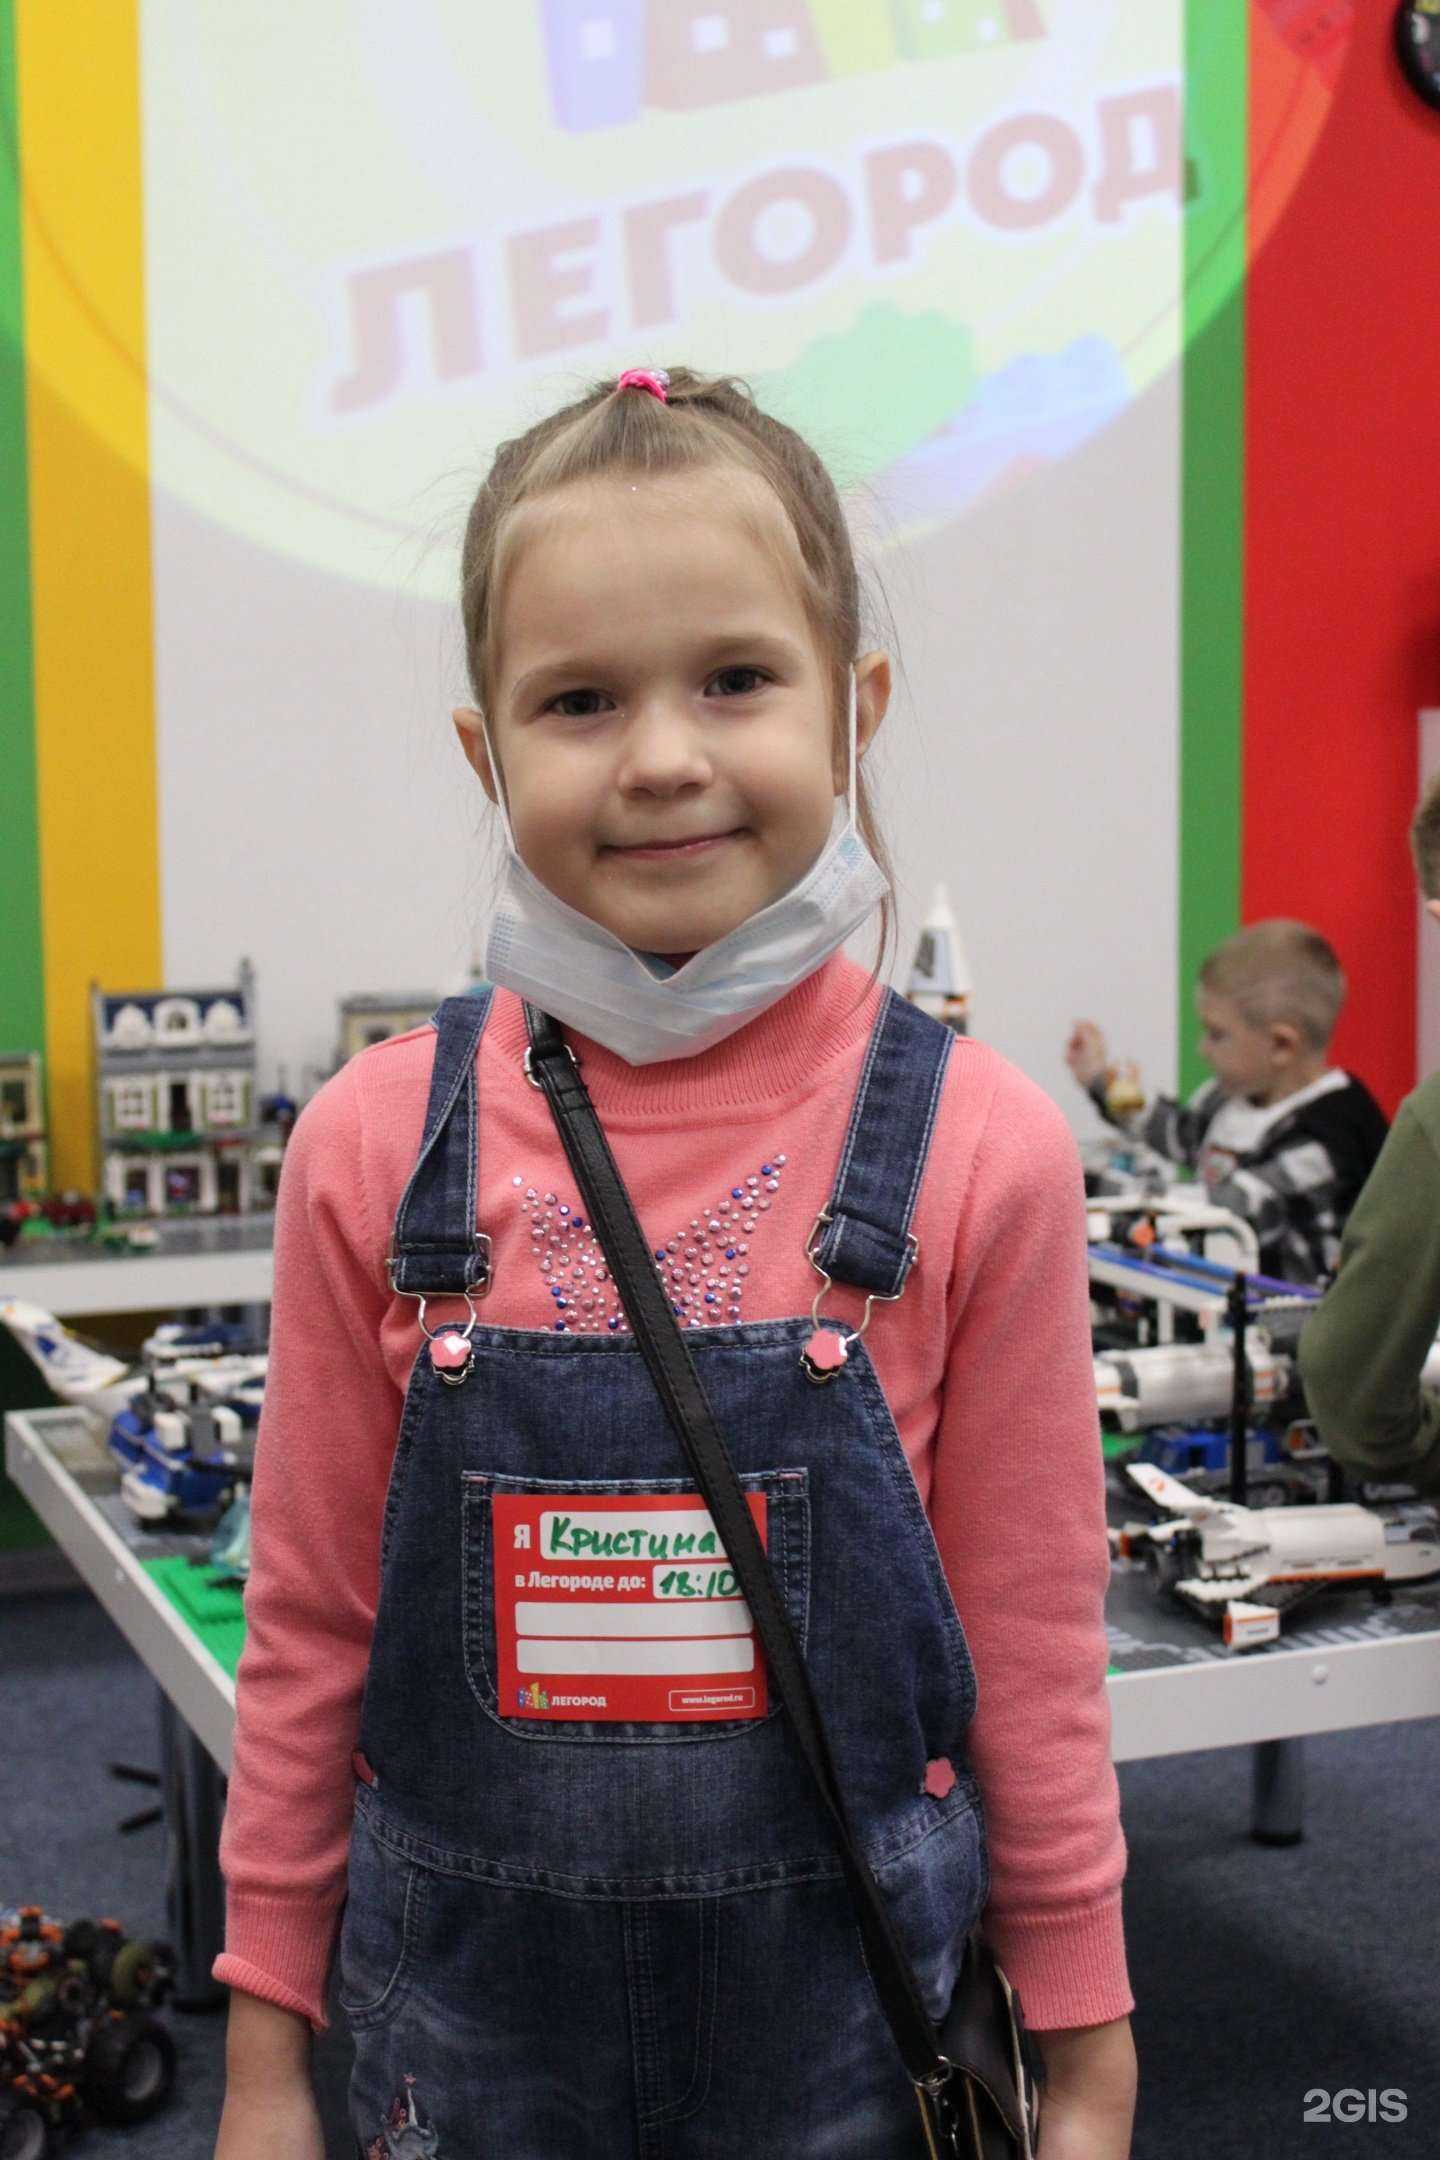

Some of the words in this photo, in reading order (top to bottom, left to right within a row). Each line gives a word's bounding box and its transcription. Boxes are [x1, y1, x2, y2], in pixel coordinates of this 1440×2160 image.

[332, 83, 1200, 414] ЛЕГОРОД
[513, 1524, 531, 1549] Я
[550, 1516, 716, 1560] Кристина
[514, 1574, 525, 1588] в
[527, 1571, 615, 1592] Легороде
[617, 1576, 646, 1592] до:
[659, 1570, 738, 1600] 18:10
[551, 1695, 607, 1708] ЛЕГОРОД
